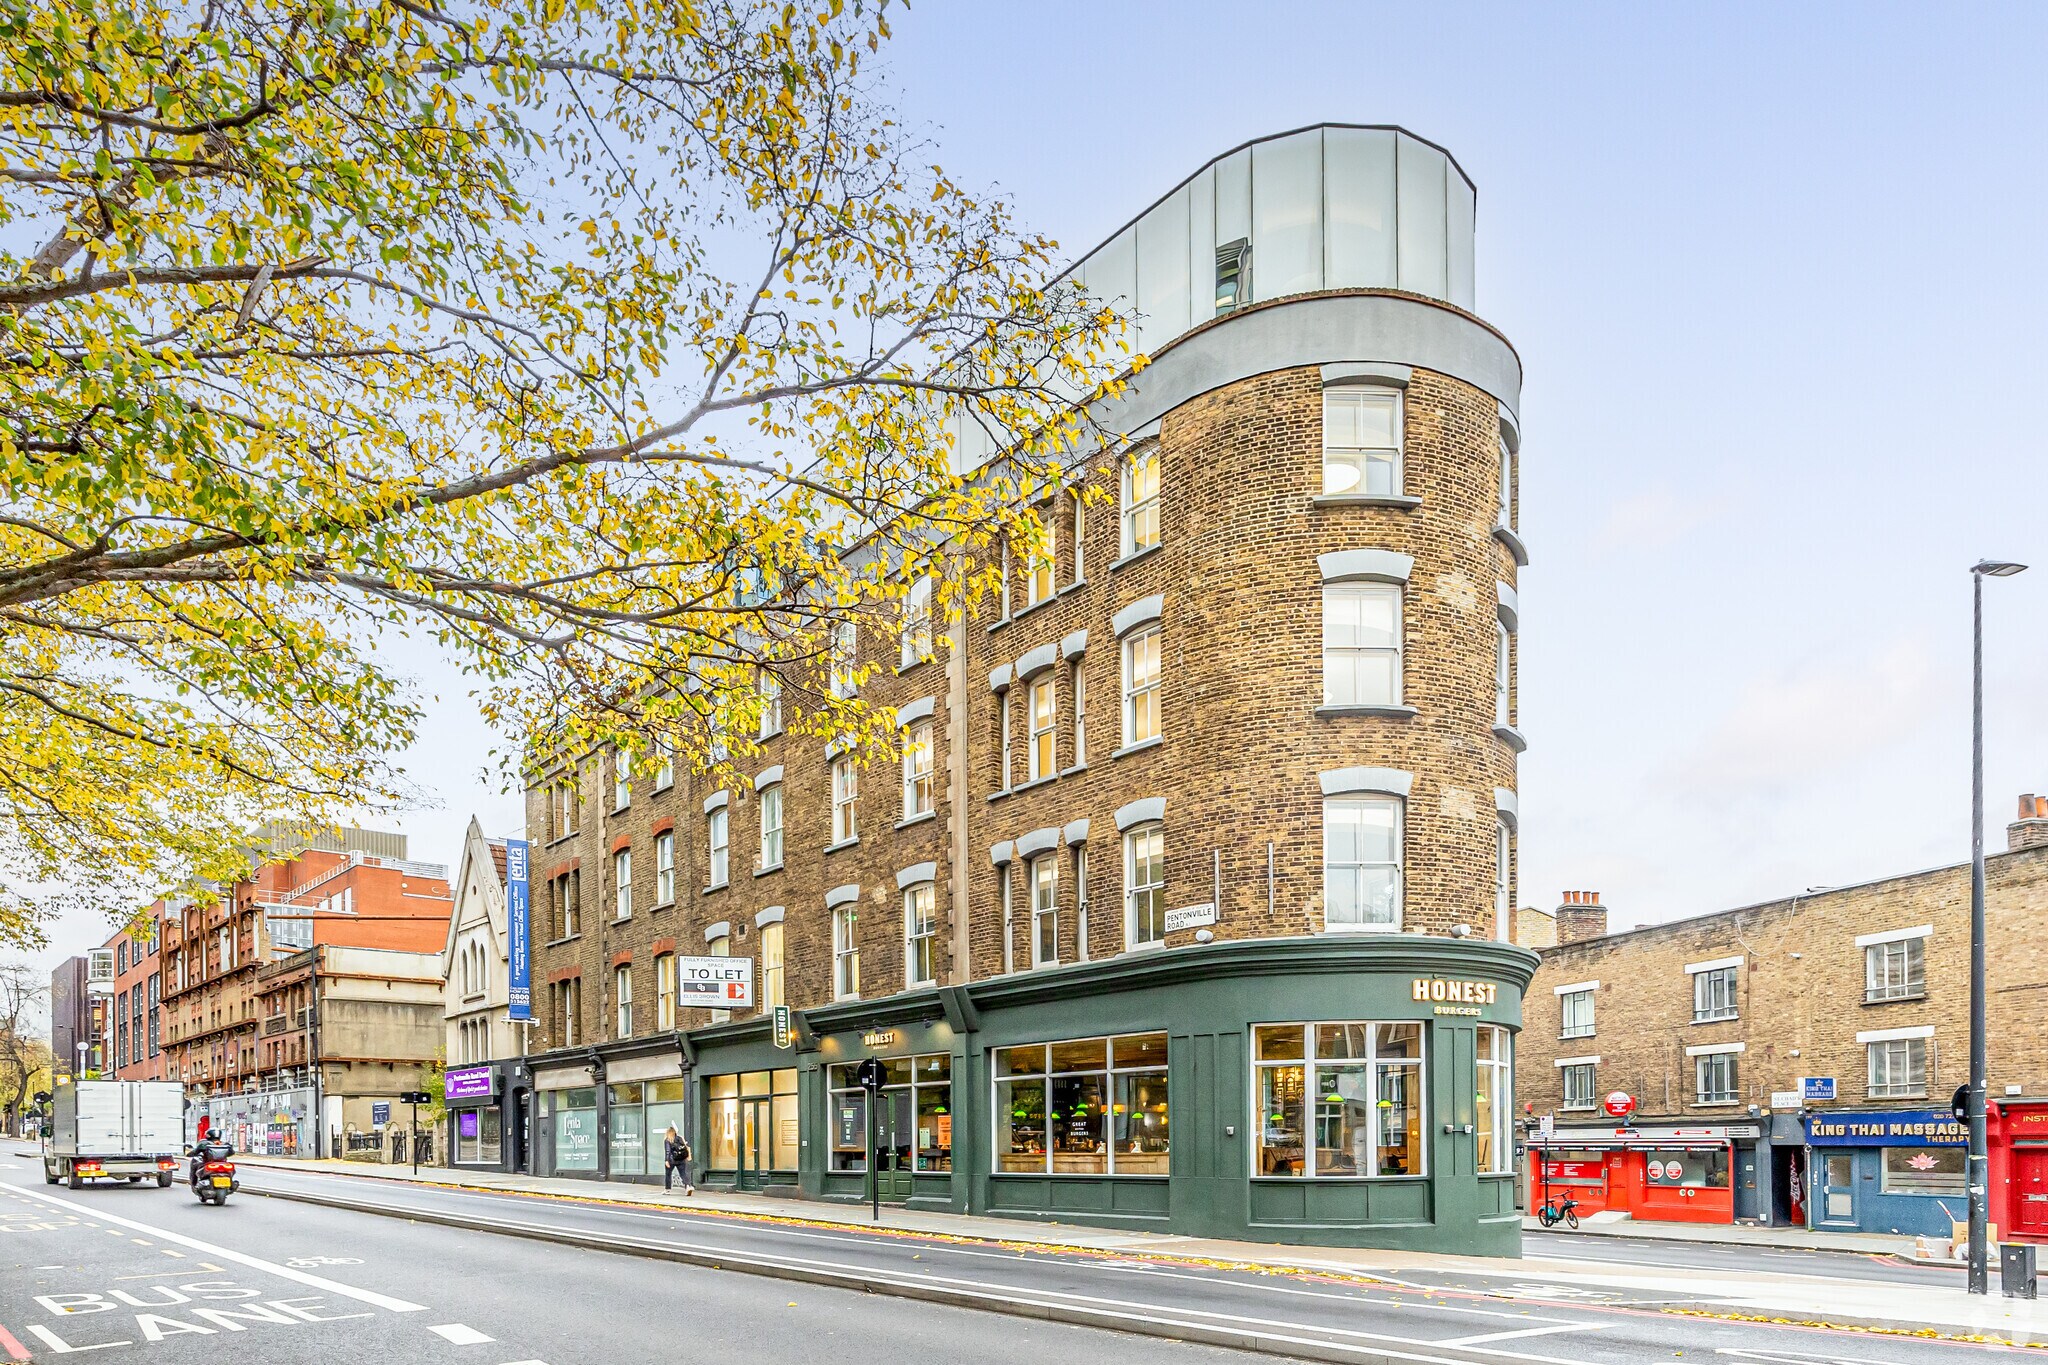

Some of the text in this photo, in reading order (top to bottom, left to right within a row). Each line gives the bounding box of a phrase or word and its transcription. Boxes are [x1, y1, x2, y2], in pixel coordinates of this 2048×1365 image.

[1166, 908, 1212, 922] PENTONVILLE
[1167, 920, 1185, 930] ROAD
[688, 968, 744, 980] TO LET
[1412, 979, 1497, 1004] HONEST
[1433, 1005, 1482, 1016] BURGERS
[777, 1009, 787, 1044] HONEST
[864, 1032, 894, 1046] HONEST
[1811, 1122, 1970, 1136] KING THAI MASSAGE
[569, 1130, 590, 1150] Space
[1925, 1135, 1970, 1143] THERAPY
[33, 1281, 262, 1316] BUS
[25, 1296, 376, 1353] LANE
